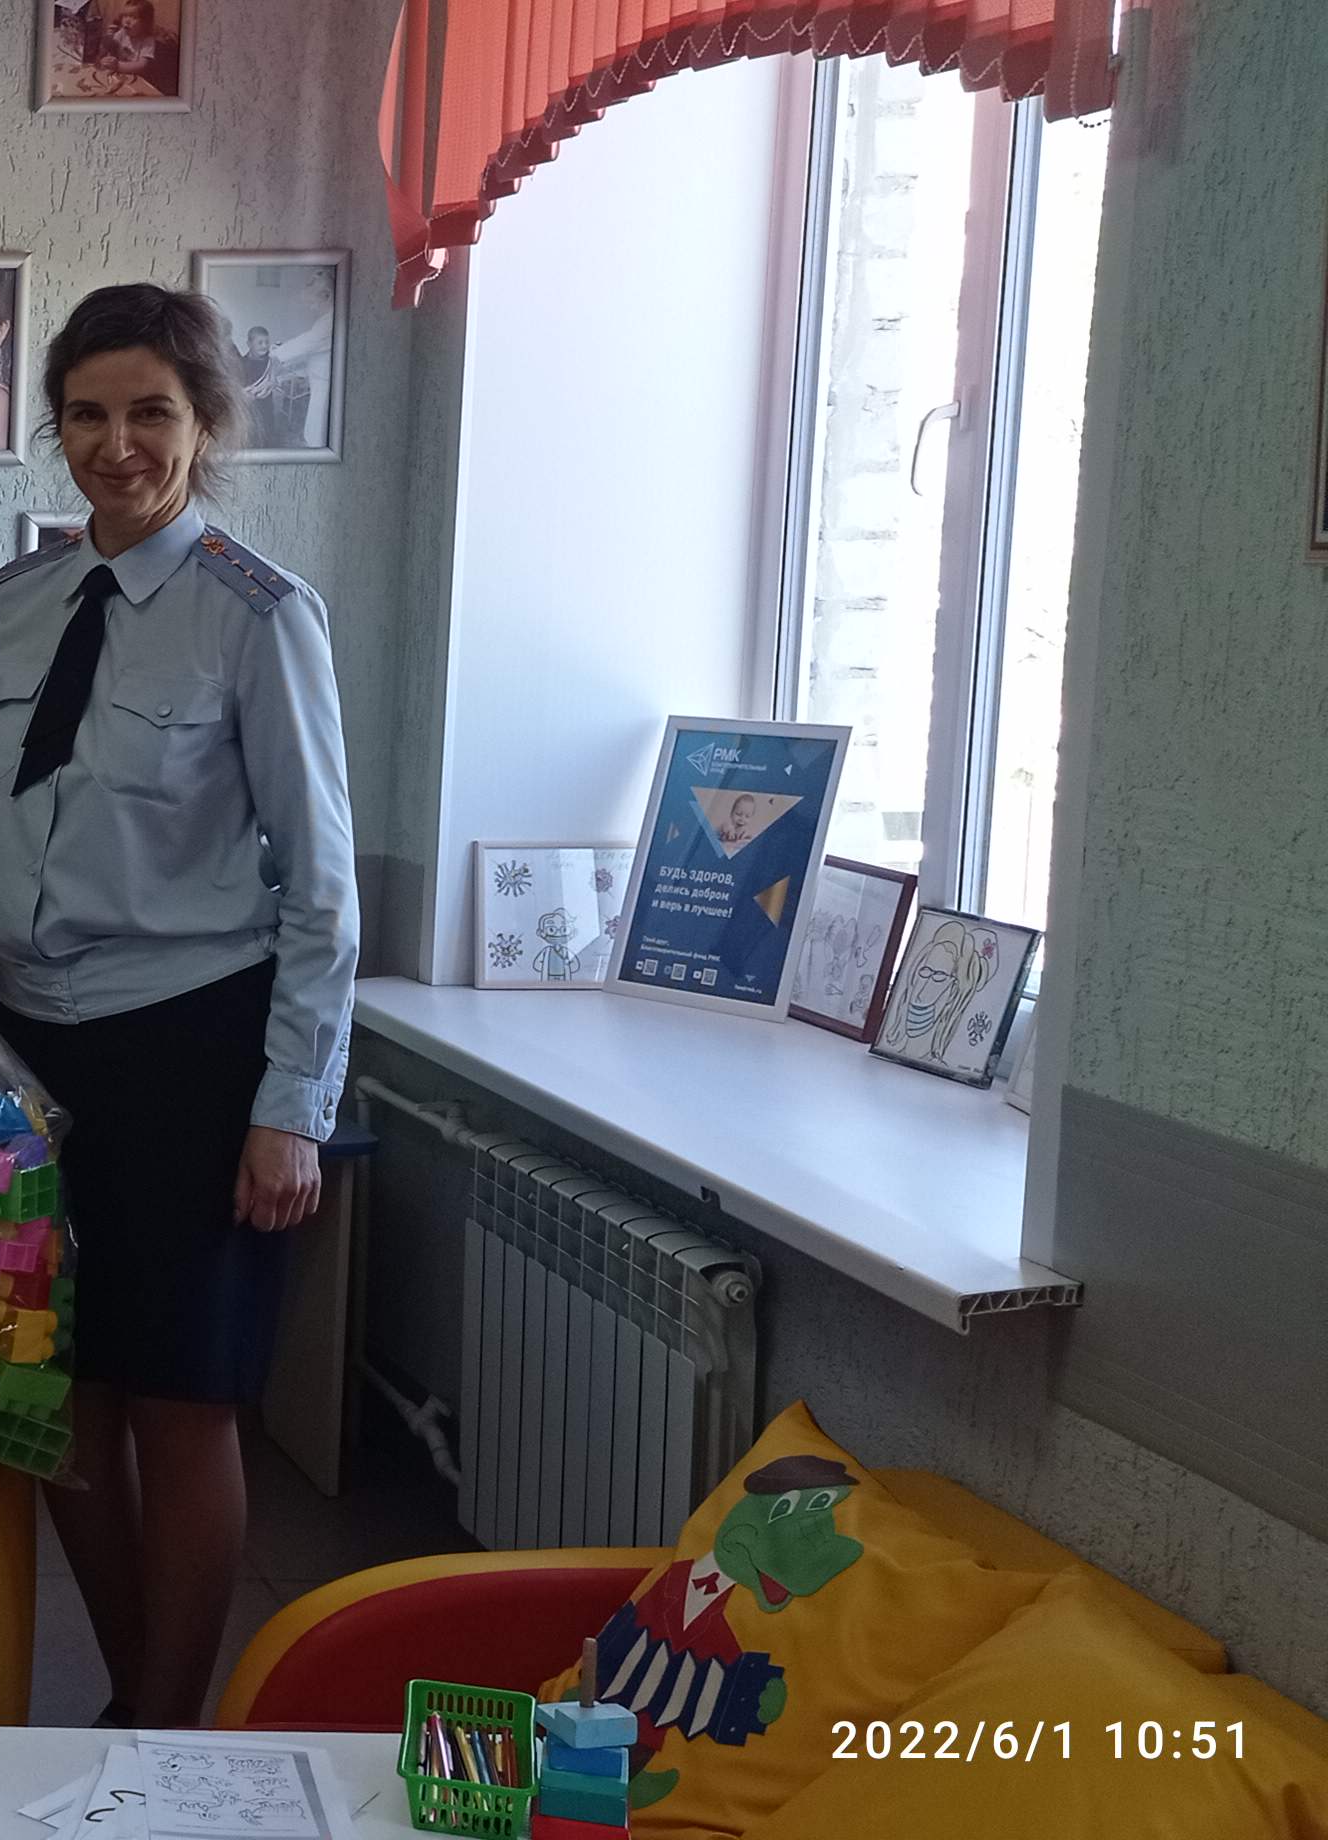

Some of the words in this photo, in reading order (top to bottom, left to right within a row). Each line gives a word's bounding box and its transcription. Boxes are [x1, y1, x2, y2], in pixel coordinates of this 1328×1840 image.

[713, 747, 742, 762] РМК
[659, 866, 688, 880] БУДЬ
[654, 883, 690, 896] делись
[691, 887, 730, 901] добром
[651, 899, 660, 908] и
[659, 900, 683, 912] верь
[683, 903, 691, 912] в
[691, 904, 734, 918] лучшее!
